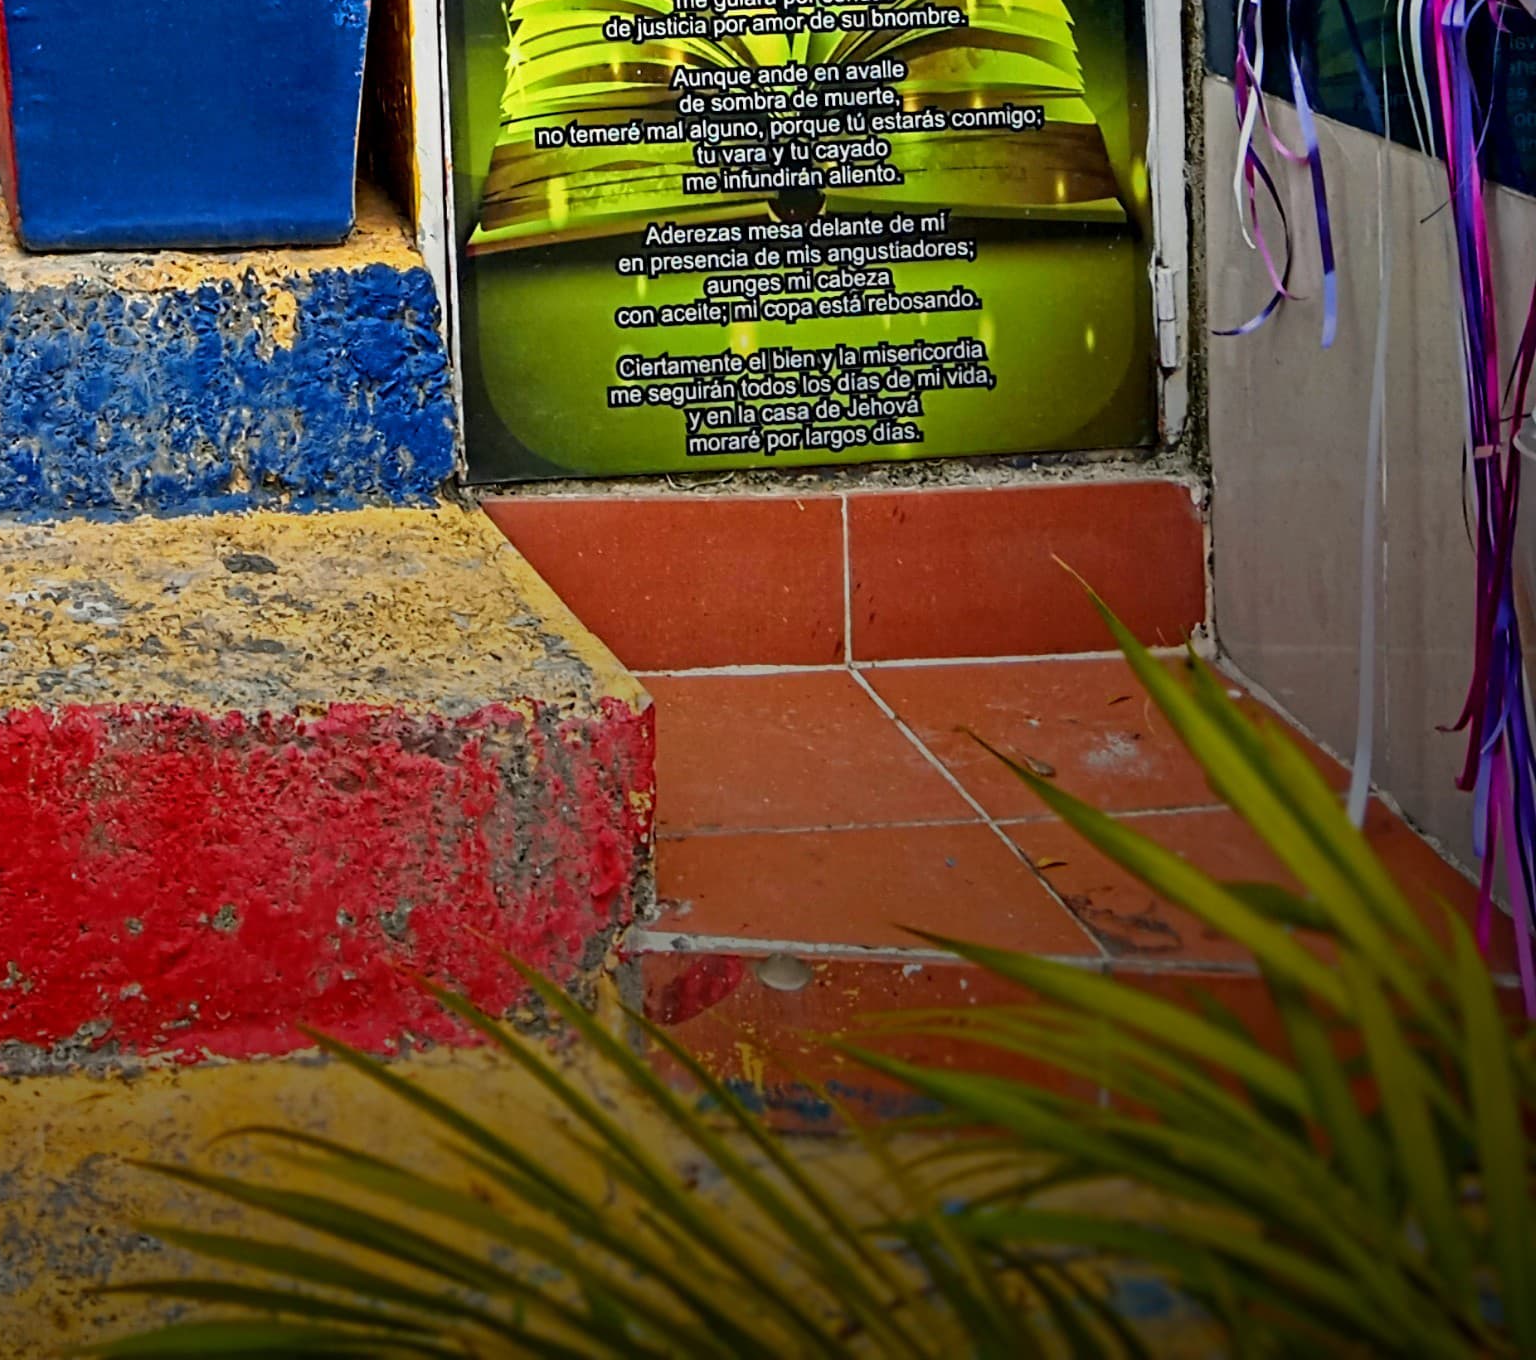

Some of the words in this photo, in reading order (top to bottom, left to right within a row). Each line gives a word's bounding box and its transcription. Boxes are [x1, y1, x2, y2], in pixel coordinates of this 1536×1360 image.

[674, 68, 751, 89] Aunque
[758, 64, 808, 84] ande
[814, 66, 840, 82] en
[846, 60, 905, 80] avalle
[679, 94, 705, 113] de
[712, 91, 787, 111] sombra
[792, 84, 818, 108] de
[825, 88, 899, 108] muerte,
[538, 130, 563, 145] no
[569, 126, 641, 144] temeré
[647, 120, 684, 140] mal
[690, 120, 764, 144] alguno,
[770, 118, 840, 142] porque
[846, 112, 866, 132] tú
[868, 109, 946, 131] estarás
[951, 109, 1041, 129] conmigo;
[618, 257, 644, 273] en
[650, 252, 748, 276] presencia
[754, 247, 780, 266] de
[786, 244, 822, 264] mis
[827, 239, 974, 266] angustiadores;
[618, 309, 654, 325] con
[661, 303, 727, 323] aceite;
[735, 301, 758, 318] mi
[759, 299, 813, 321] copa
[819, 296, 862, 314] está
[868, 289, 978, 312] rebosando.
[689, 434, 764, 452] moraré
[767, 432, 803, 452] por
[805, 427, 867, 449] largos
